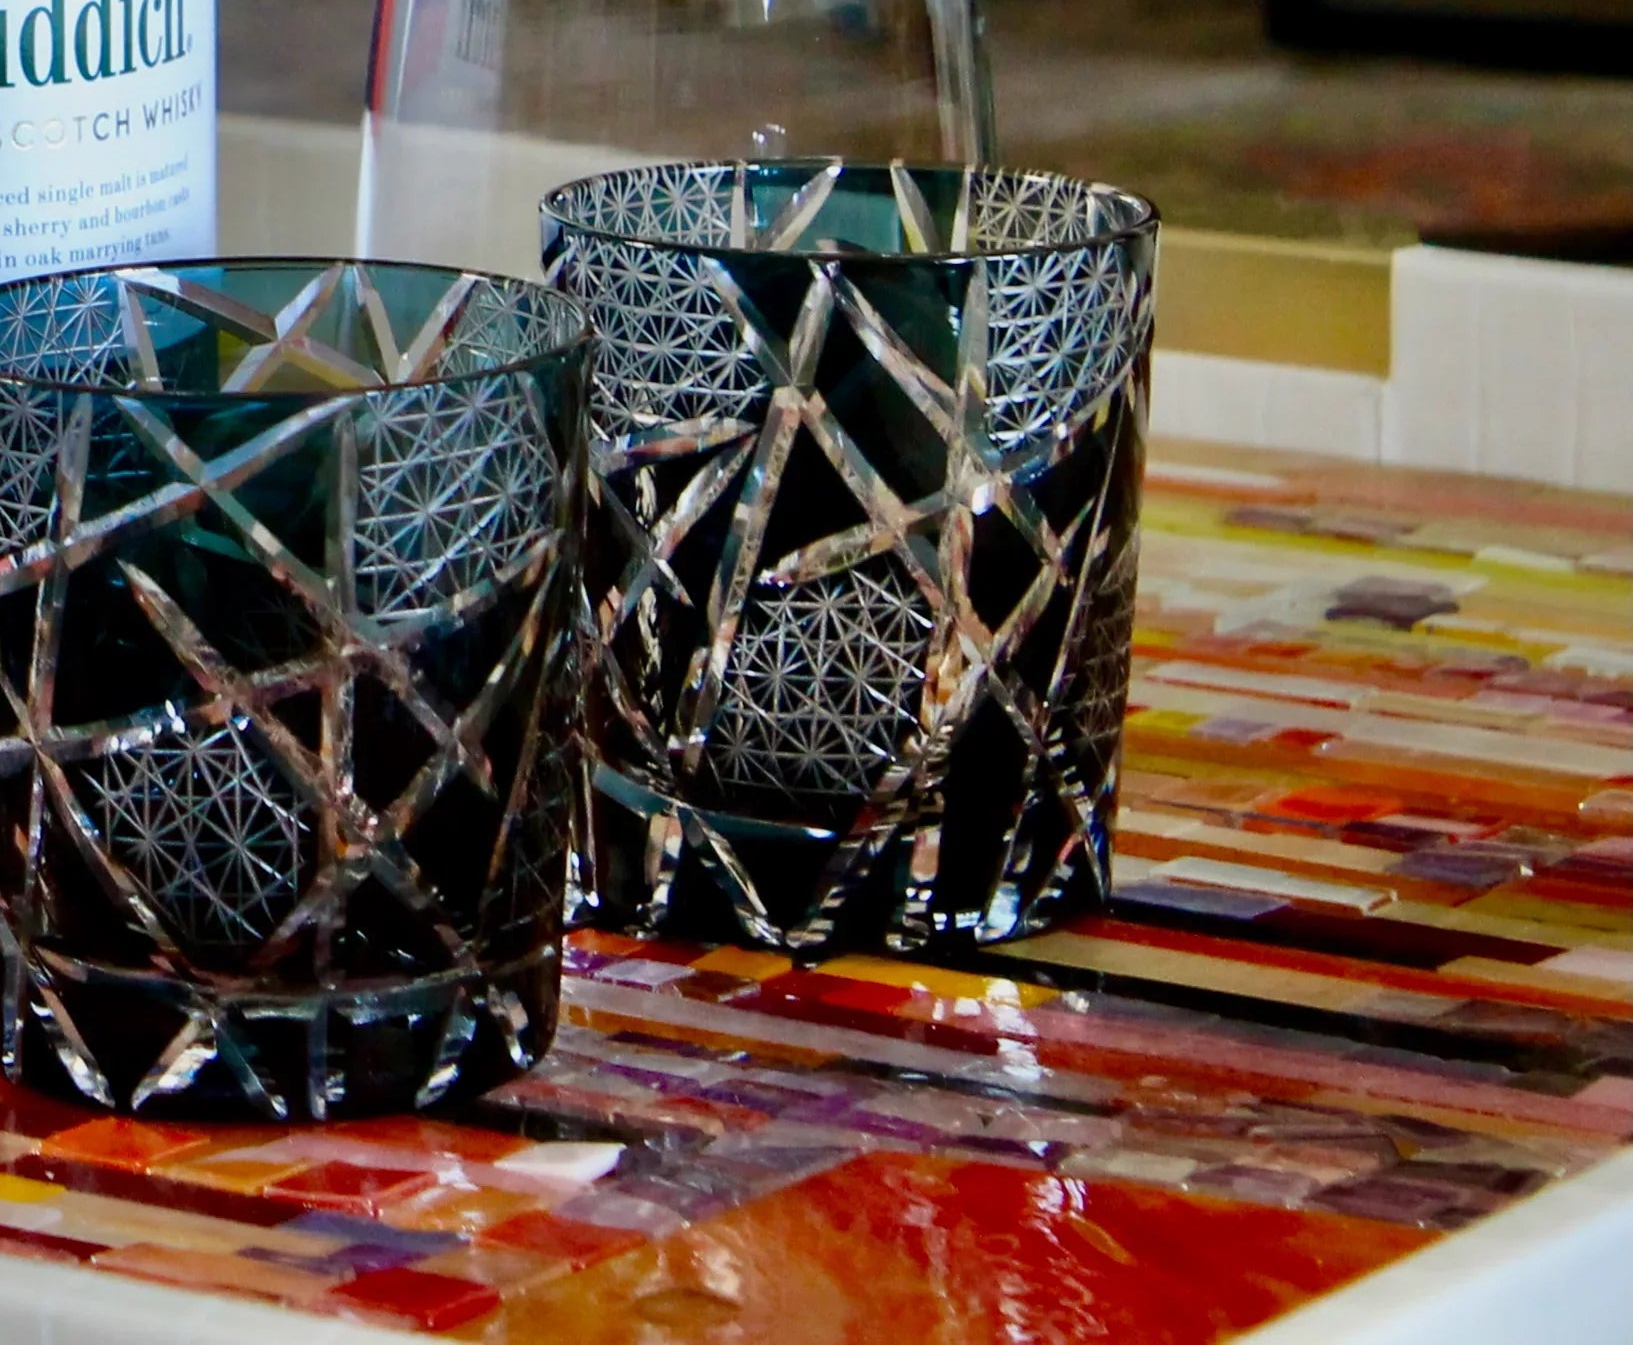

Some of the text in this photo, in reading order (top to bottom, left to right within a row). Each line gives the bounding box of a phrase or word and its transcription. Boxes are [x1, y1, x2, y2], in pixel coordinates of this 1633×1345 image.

[143, 82, 203, 131] WHISKY
[38, 181, 93, 203] single
[100, 173, 131, 196] malt
[136, 169, 146, 187] is
[3, 218, 71, 238] sherry
[79, 208, 110, 230] and
[25, 247, 62, 266] oak
[69, 235, 142, 262] marrying
